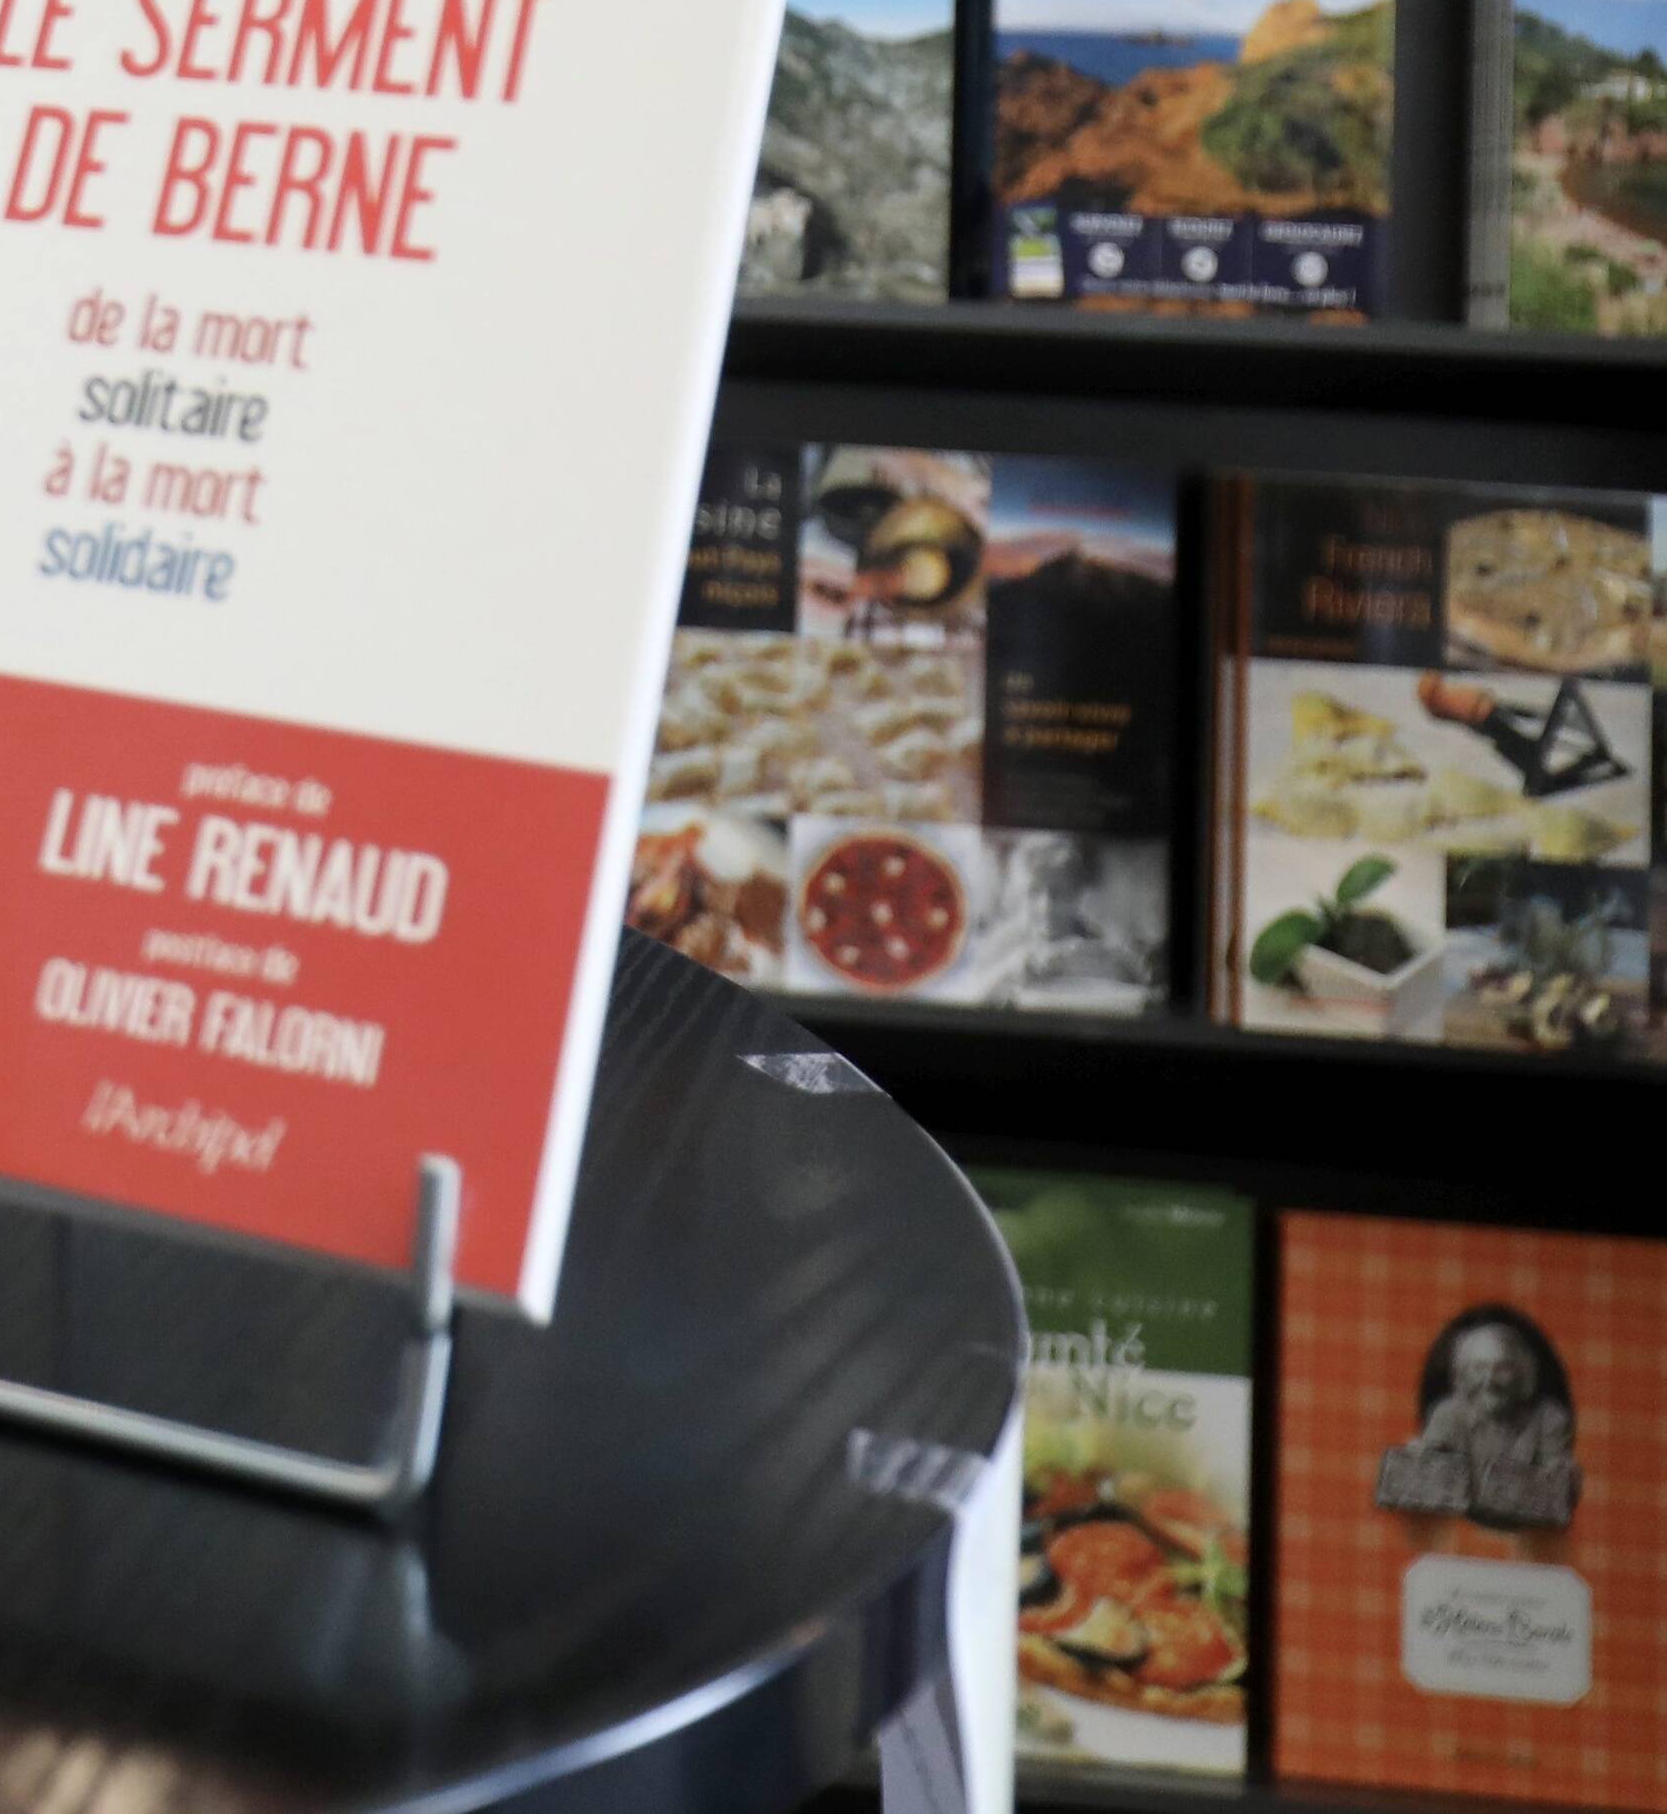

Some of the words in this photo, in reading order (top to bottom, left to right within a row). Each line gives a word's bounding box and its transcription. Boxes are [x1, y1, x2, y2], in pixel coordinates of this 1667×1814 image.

[3, 103, 130, 231] DE
[152, 114, 459, 264] BERNE
[69, 288, 125, 347] de
[138, 294, 181, 355] la
[194, 307, 313, 371] mort
[78, 369, 269, 444] solitaire
[43, 443, 71, 498] à
[89, 446, 129, 506] la
[145, 459, 267, 526] mort
[39, 521, 236, 604] solidaire
[1324, 540, 1434, 574] French
[1303, 582, 1433, 628] Riviera
[179, 760, 289, 812] préface
[294, 775, 332, 817] de
[38, 788, 181, 894] LINE
[187, 815, 450, 946] RENAUD
[140, 926, 255, 979] postface
[260, 946, 300, 985] de
[33, 956, 196, 1049] OLIVIER
[202, 993, 386, 1089] FALORNI
[1068, 1370, 1198, 1431] Nice
